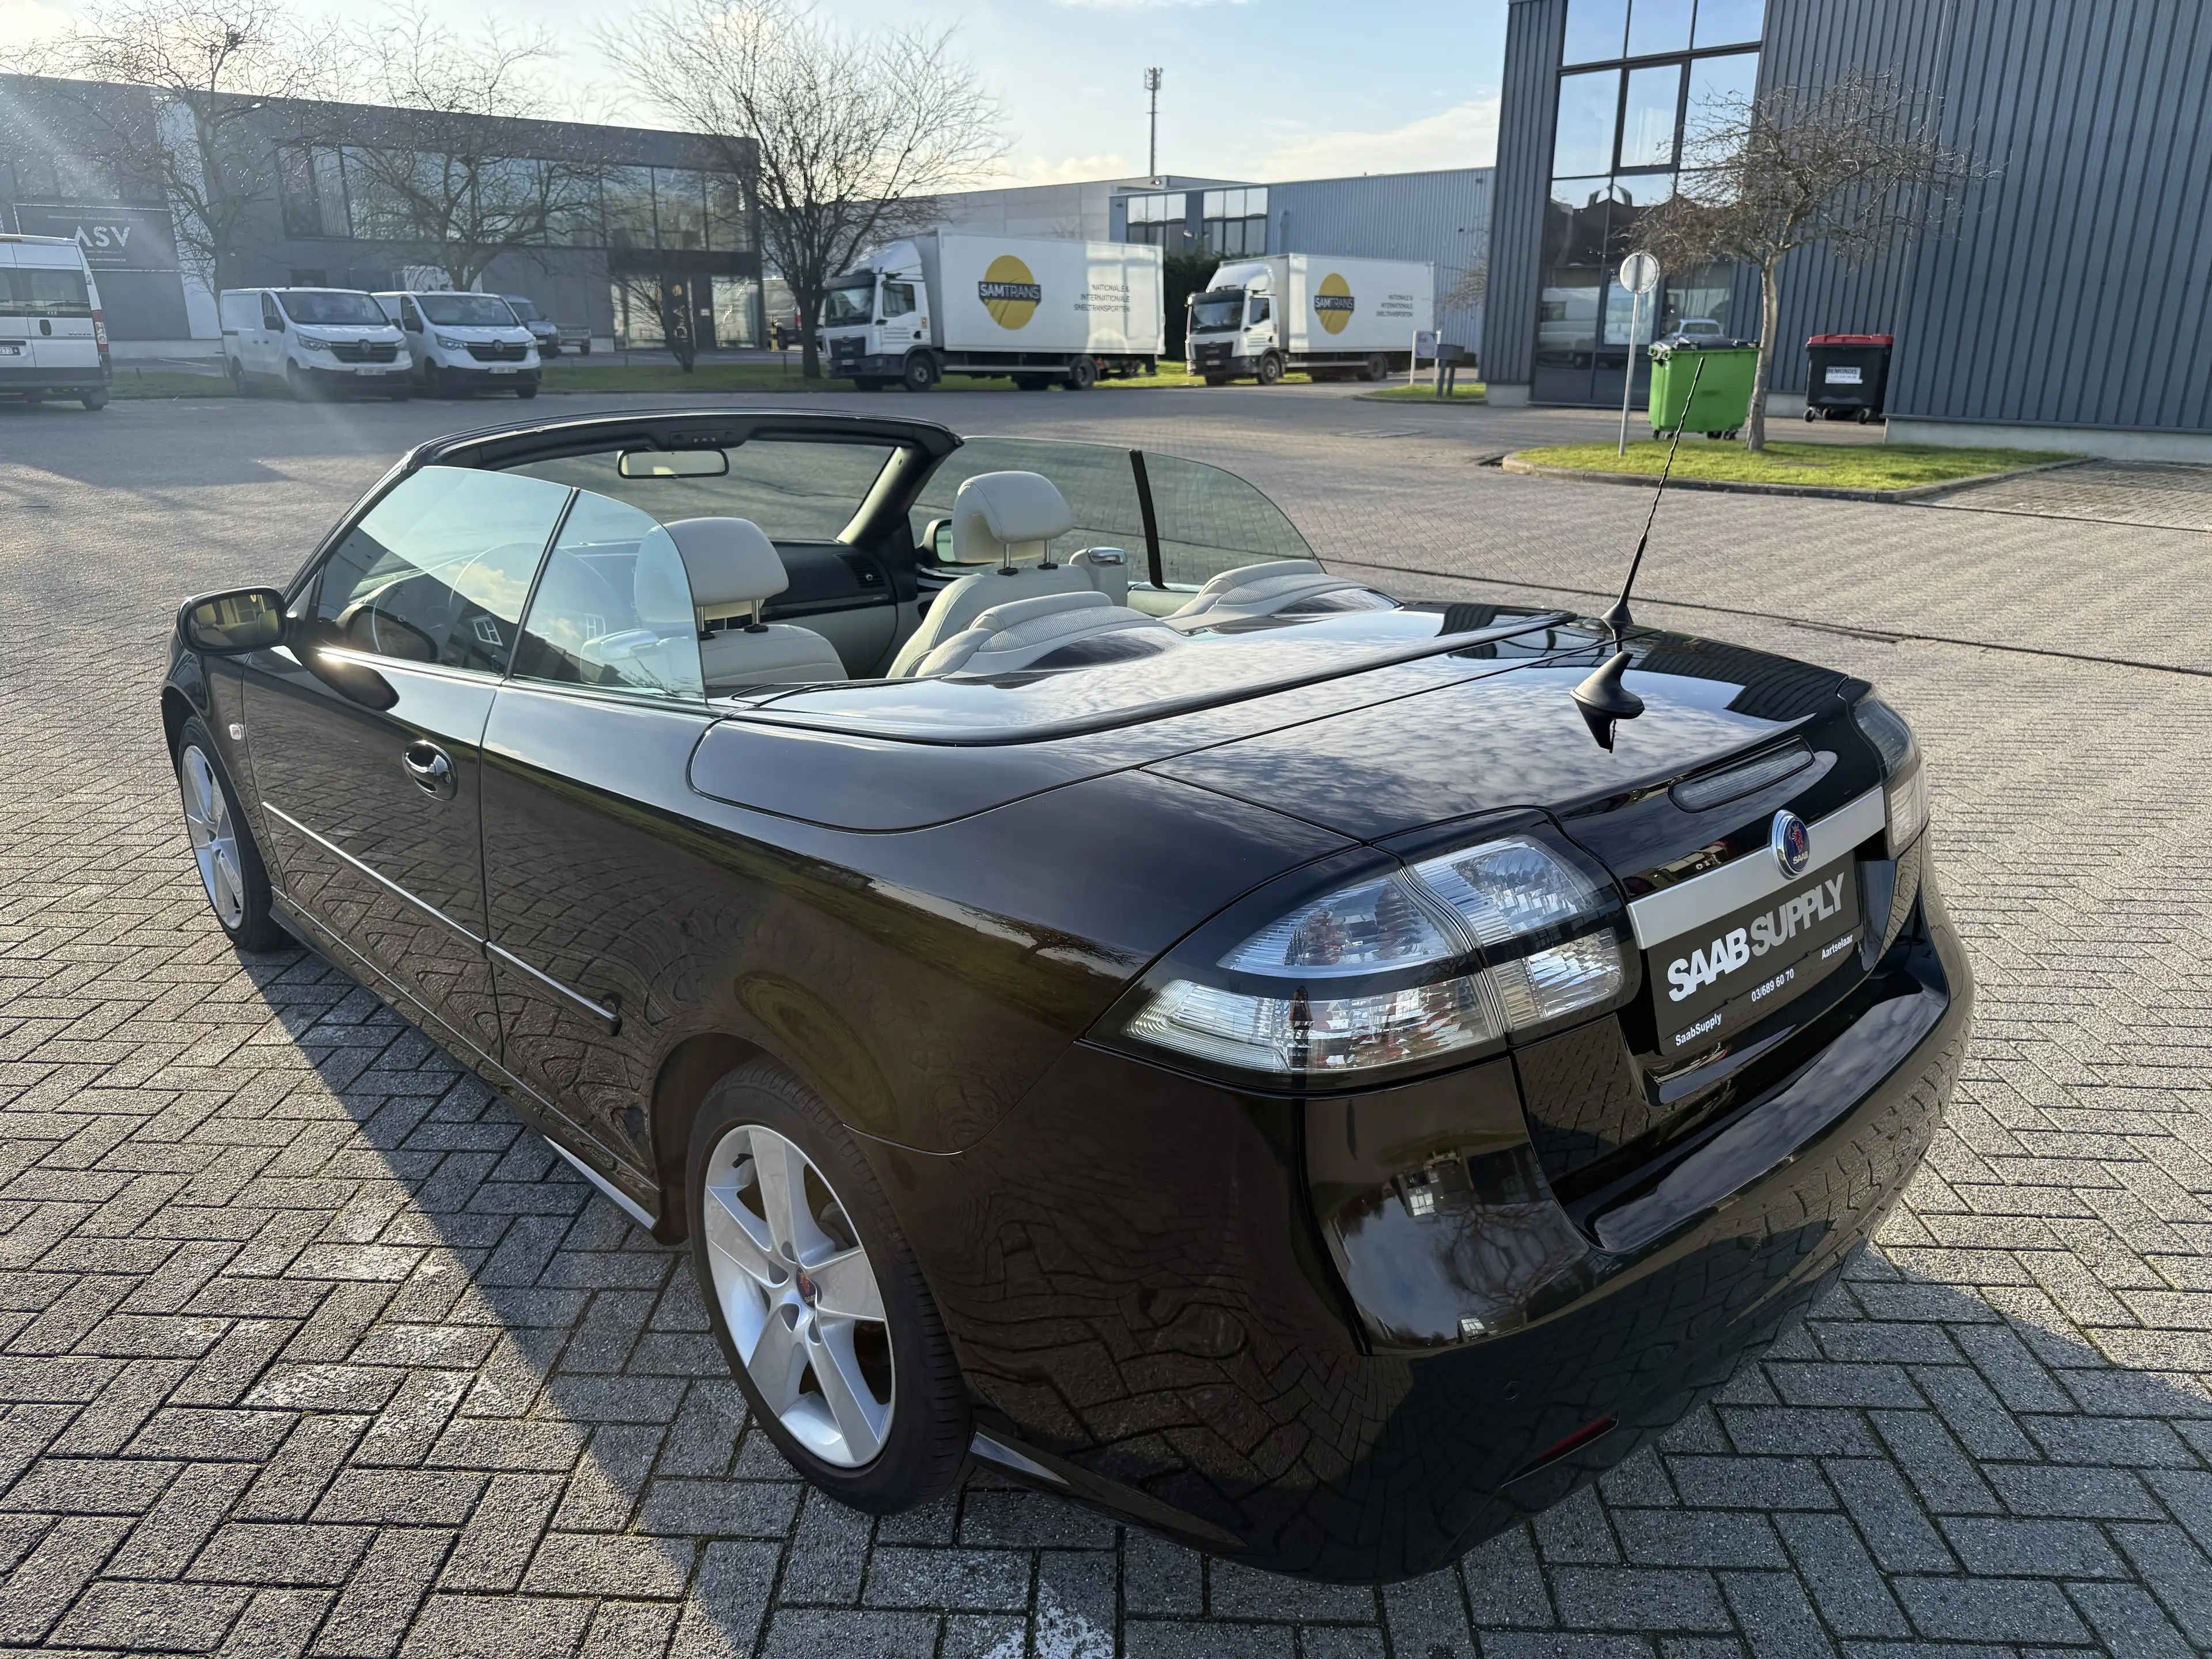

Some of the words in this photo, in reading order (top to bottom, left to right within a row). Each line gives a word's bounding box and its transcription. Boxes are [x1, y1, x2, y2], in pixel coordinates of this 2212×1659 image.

[74, 226, 130, 247] ASV
[980, 283, 1040, 299] SAMTRANS
[1315, 297, 1354, 309] SAMTRANS
[1793, 851, 1808, 864] SAAB
[1668, 927, 1750, 1002] SAAB
[1751, 872, 1844, 956] SUPPLY
[1675, 1013, 1722, 1046] SaabSupply
[1751, 980, 1774, 1002] 03/689
[1776, 974, 1785, 987] 60
[1786, 968, 1794, 982] 70
[1821, 934, 1853, 960] Aartselaar
